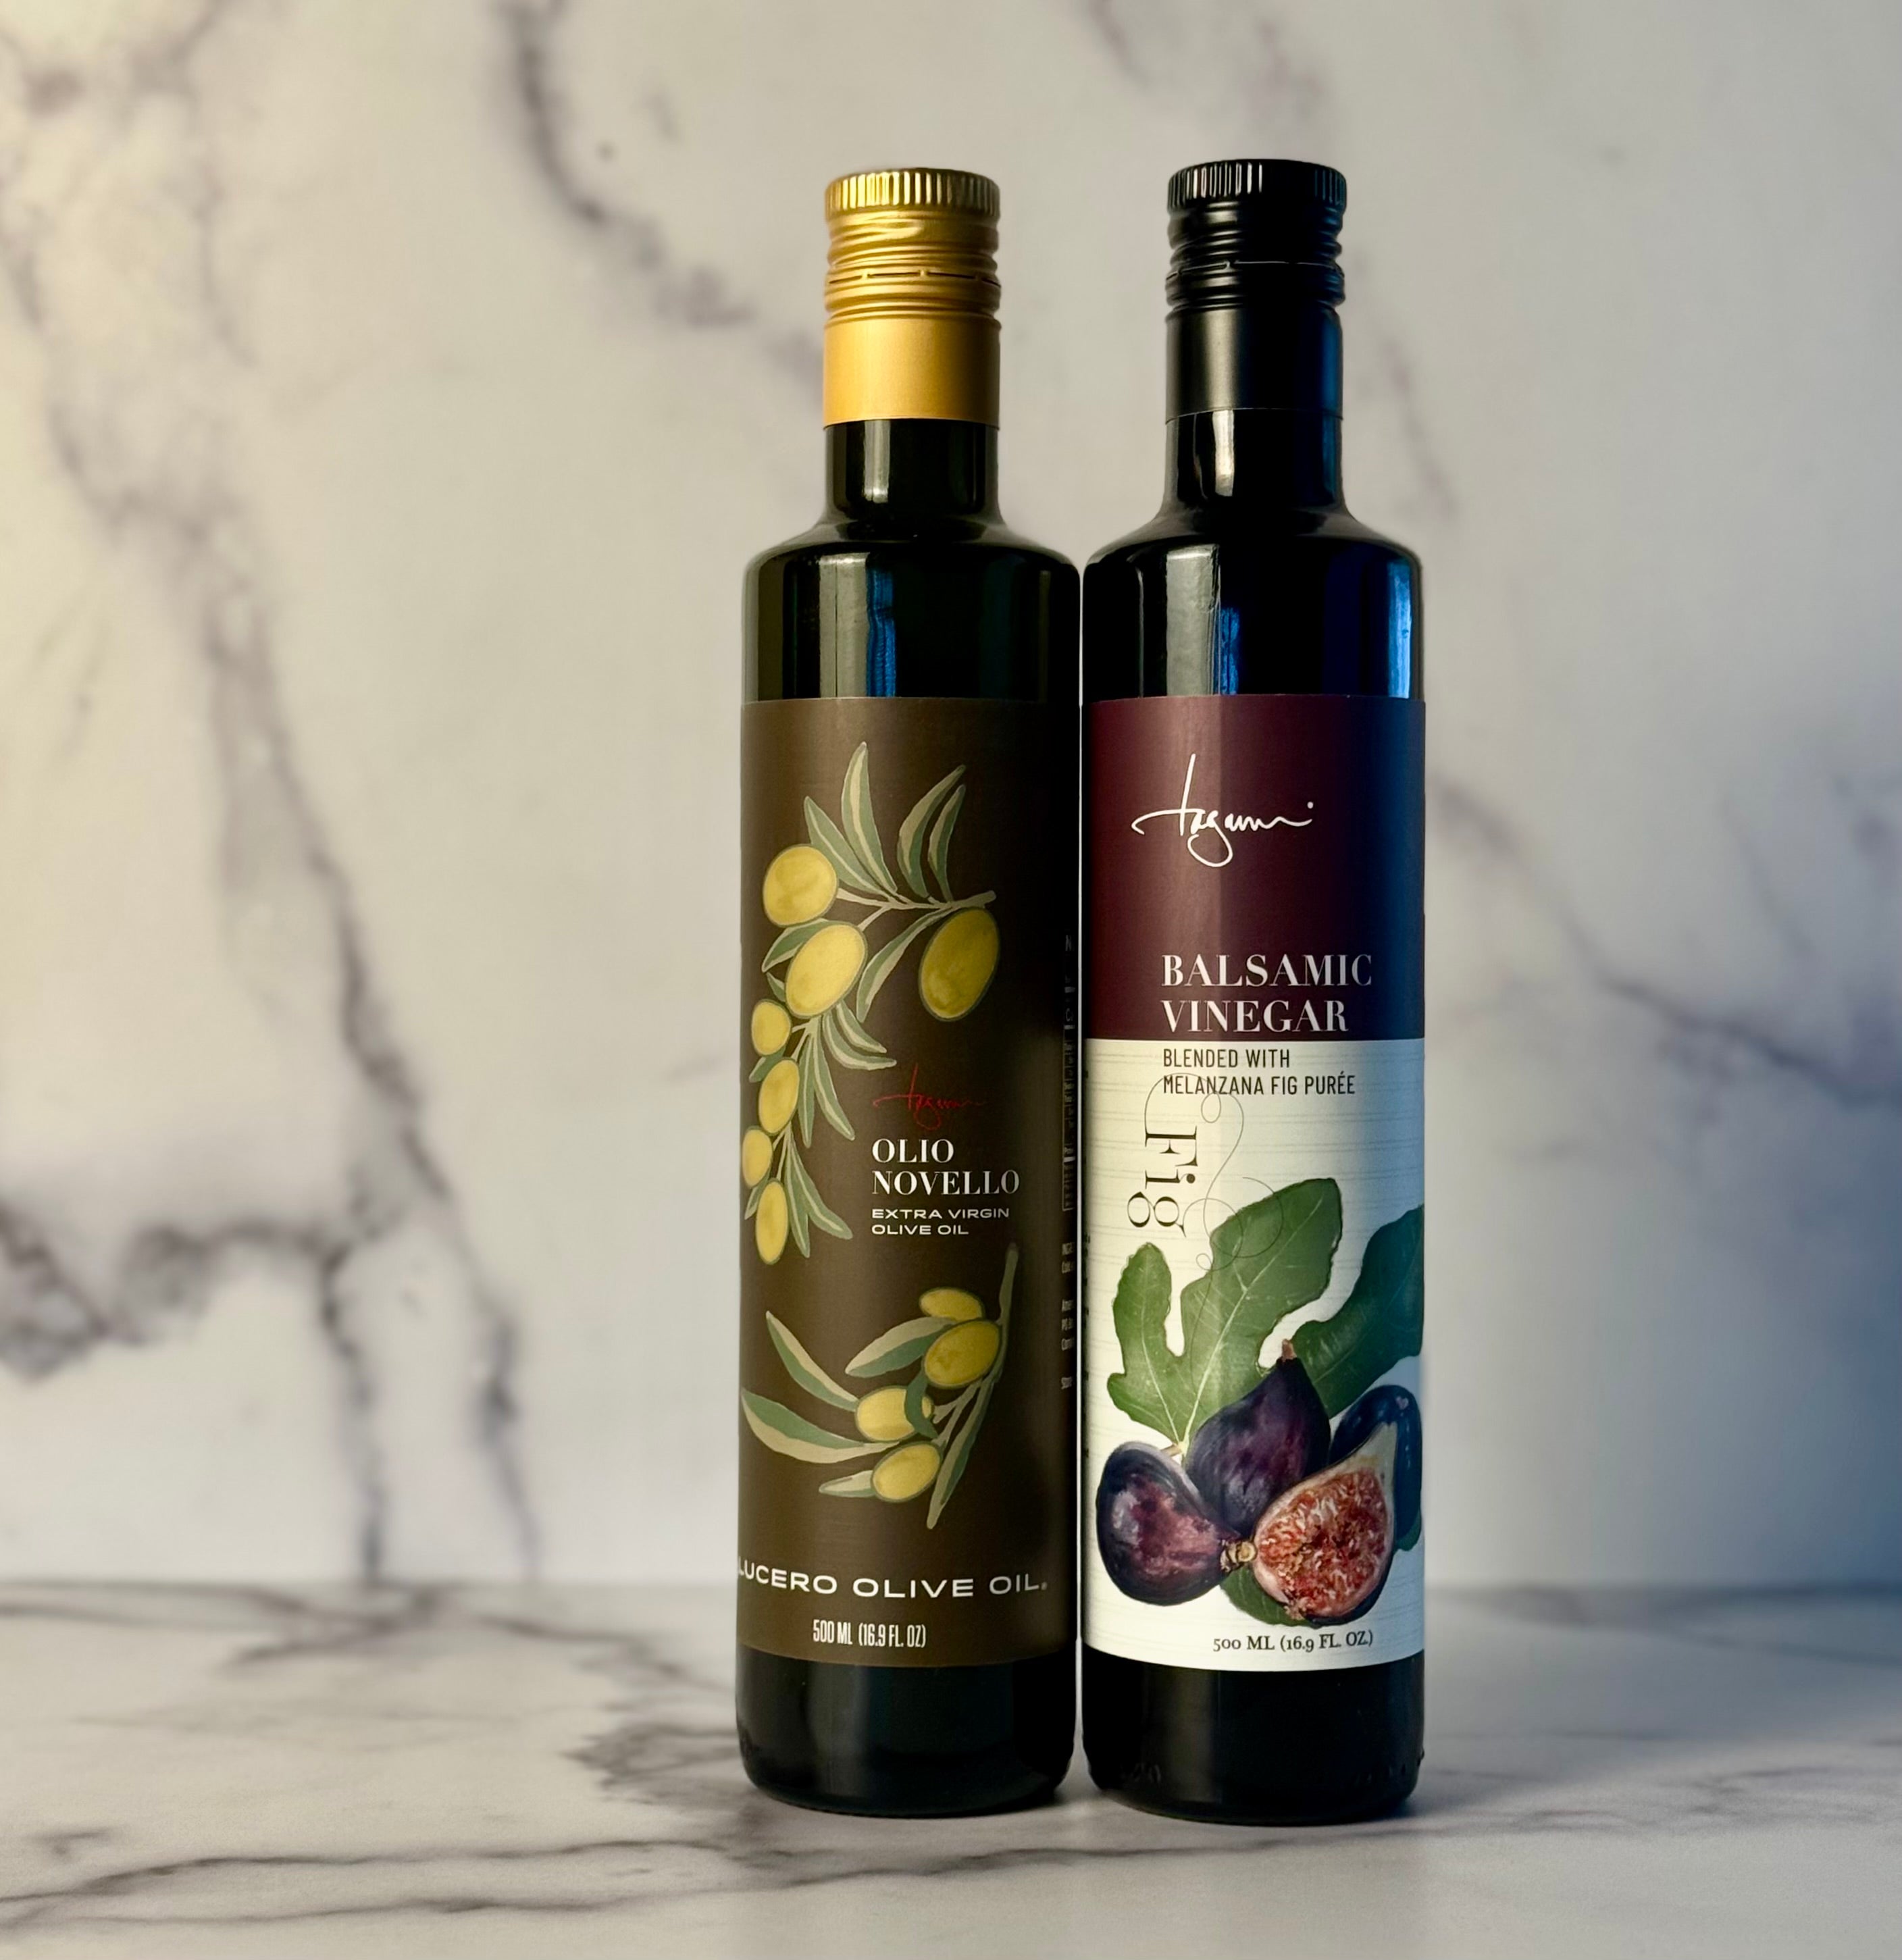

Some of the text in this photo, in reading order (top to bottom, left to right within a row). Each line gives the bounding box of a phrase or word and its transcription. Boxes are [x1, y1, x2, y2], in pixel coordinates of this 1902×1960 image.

[1161, 953, 1372, 987] BALSAMIC
[1160, 999, 1350, 1033] VINEGAR
[1162, 1048, 1291, 1068] BLENDED WITH
[1162, 1071, 1356, 1095] MELANZANA FIG PURÉE
[871, 1138, 955, 1164] OLIO
[871, 1169, 1021, 1196] NOVELLO
[1126, 1125, 1198, 1238] Fig
[871, 1207, 1010, 1220] EXTRA VIRGIN
[871, 1223, 969, 1236] OLIVE OIL
[738, 1555, 838, 1595] LUCERO
[852, 1577, 975, 1599] OLIVE
[813, 1619, 927, 1648] 500 ML (16.9 FL. OZ)
[1212, 1637, 1241, 1652] 500
[1246, 1635, 1275, 1651] ML
[1279, 1634, 1315, 1653] (16.9
